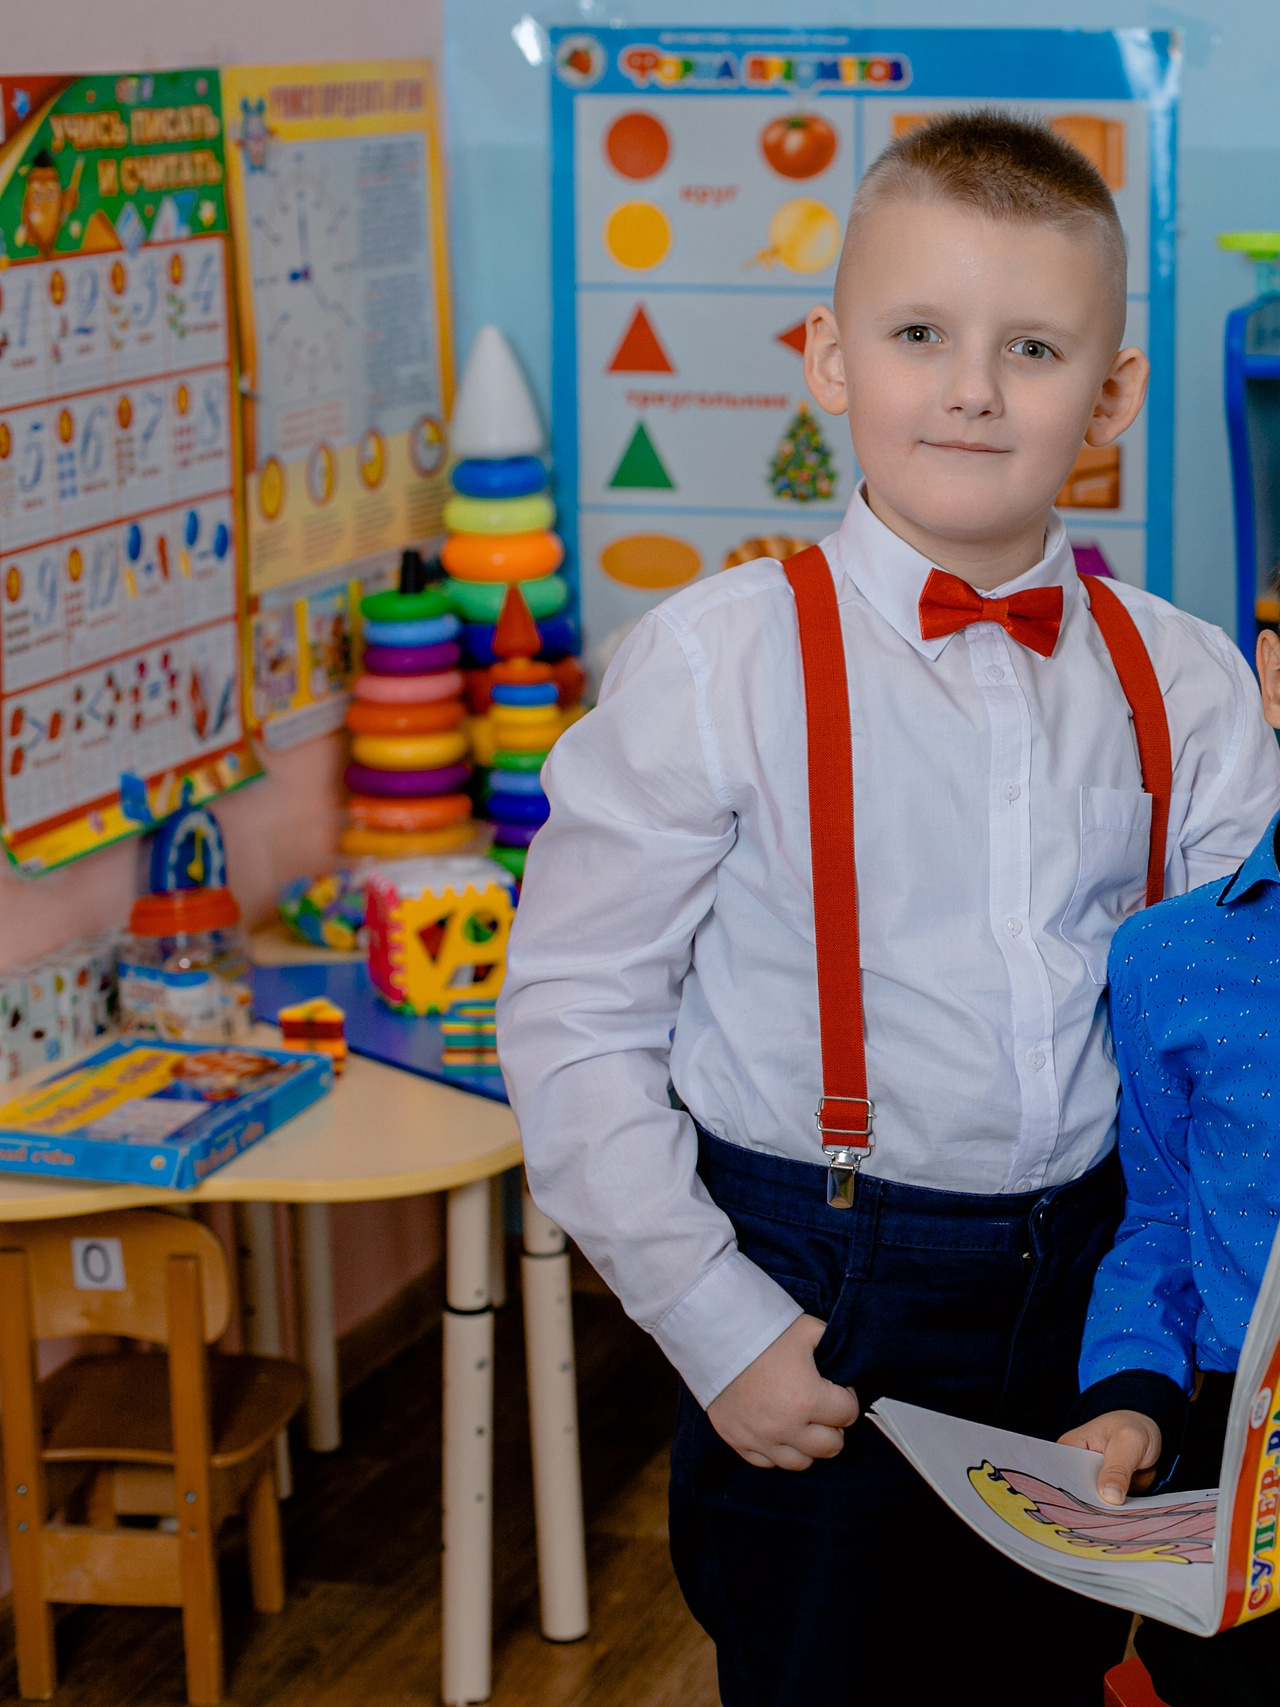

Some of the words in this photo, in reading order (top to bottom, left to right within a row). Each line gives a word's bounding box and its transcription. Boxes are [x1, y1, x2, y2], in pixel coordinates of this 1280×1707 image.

[622, 45, 736, 88] ФОРМА
[746, 53, 906, 90] ПРЕДМЕТОВ
[50, 111, 127, 153] УЧИСЬ
[131, 104, 219, 145] ПИСАТЬ
[98, 158, 118, 197] И
[120, 150, 221, 194] СЧИТАТЬ
[681, 185, 738, 208] круг
[625, 390, 788, 415] треугольник
